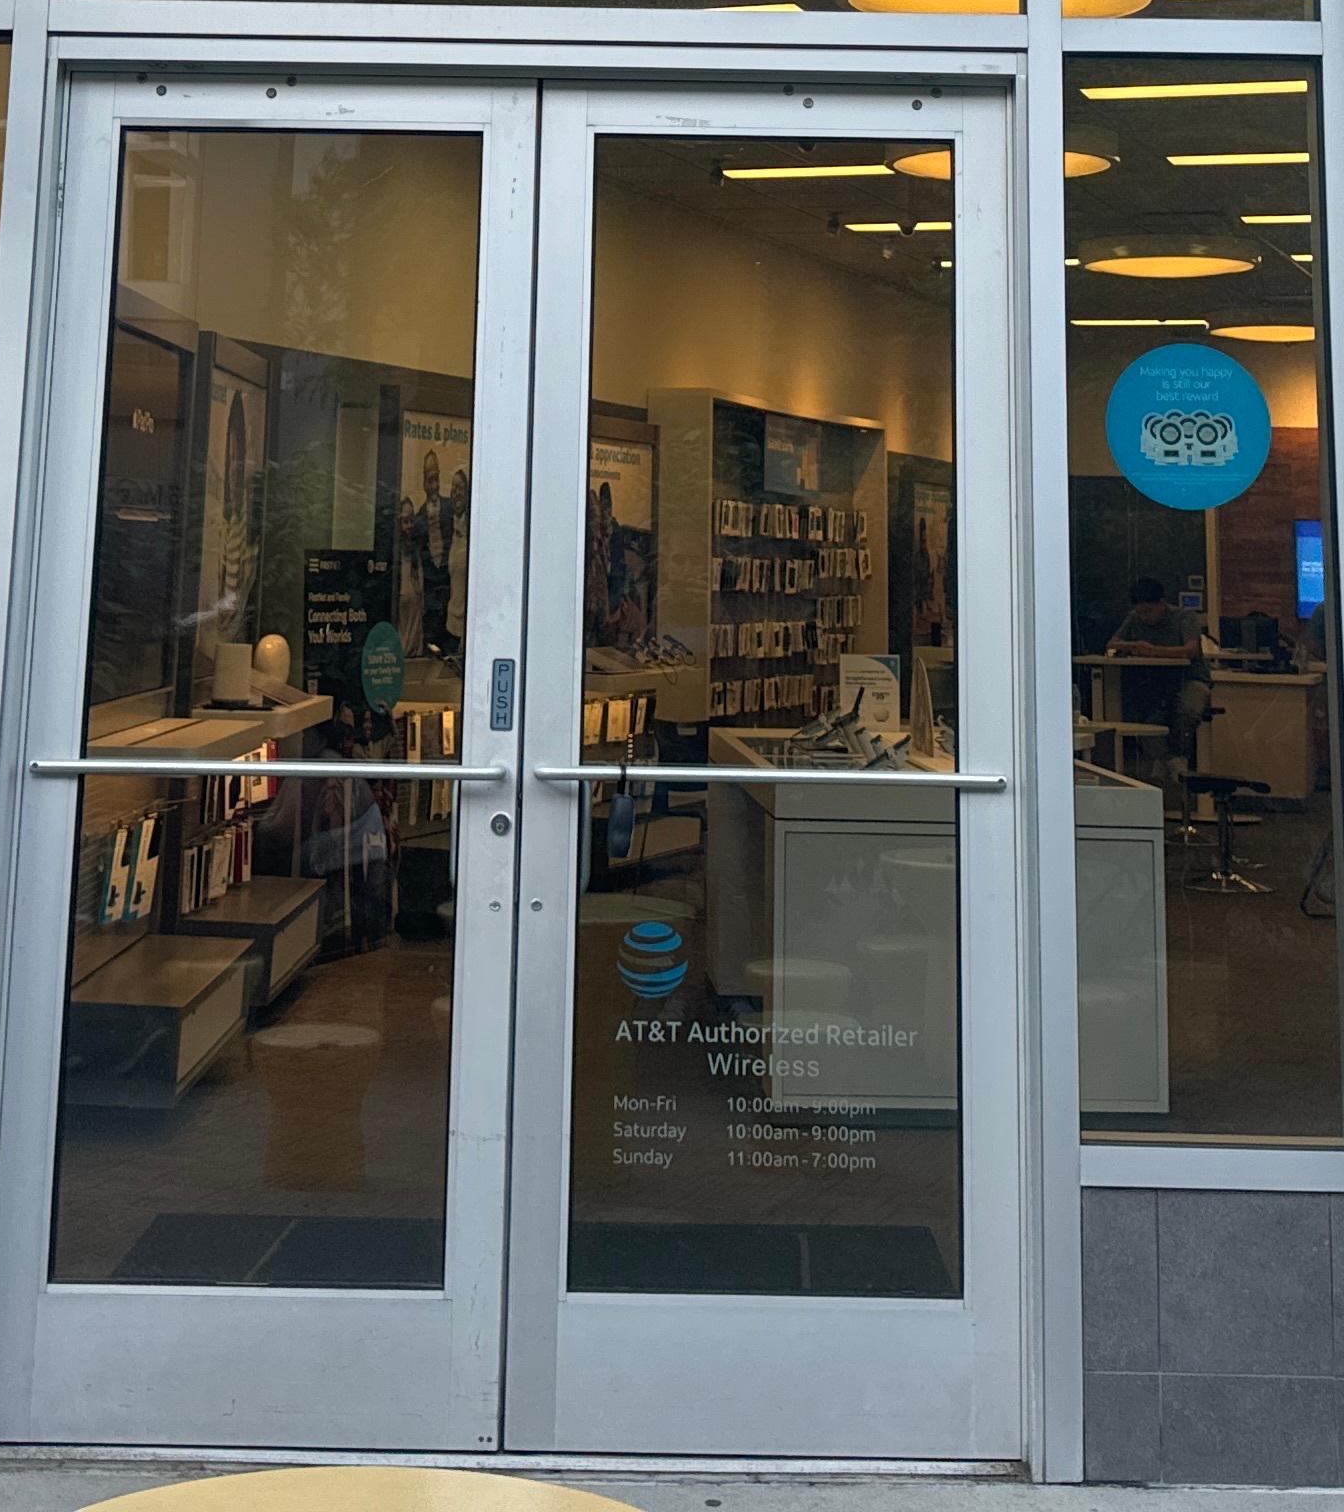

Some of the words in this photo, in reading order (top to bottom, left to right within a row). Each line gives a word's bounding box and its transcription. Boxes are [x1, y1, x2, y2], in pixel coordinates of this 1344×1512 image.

[1140, 367, 1176, 379] Making
[1179, 368, 1198, 380] you
[1202, 367, 1233, 380] happy
[1162, 379, 1170, 389] is
[1174, 379, 1190, 389] still
[1193, 380, 1210, 389] our
[1156, 391, 1178, 401] best
[1182, 391, 1219, 401] reward
[404, 419, 432, 440] Rates
[435, 422, 441, 441] &
[443, 423, 468, 446] plans
[308, 608, 347, 625] Connecting
[495, 663, 510, 724] PUSH
[615, 1020, 682, 1043] AT&T
[687, 1020, 819, 1045] Authorized
[826, 1023, 919, 1047] Retailer
[707, 1052, 821, 1077] Wireless
[613, 1095, 677, 1112] Mon-Fri
[613, 1121, 687, 1143] Saturday
[727, 1123, 799, 1140] 10:00am
[811, 1125, 876, 1145] 9:00pm
[613, 1148, 673, 1169] Sunday
[811, 1152, 876, 1173] 7:00pm
